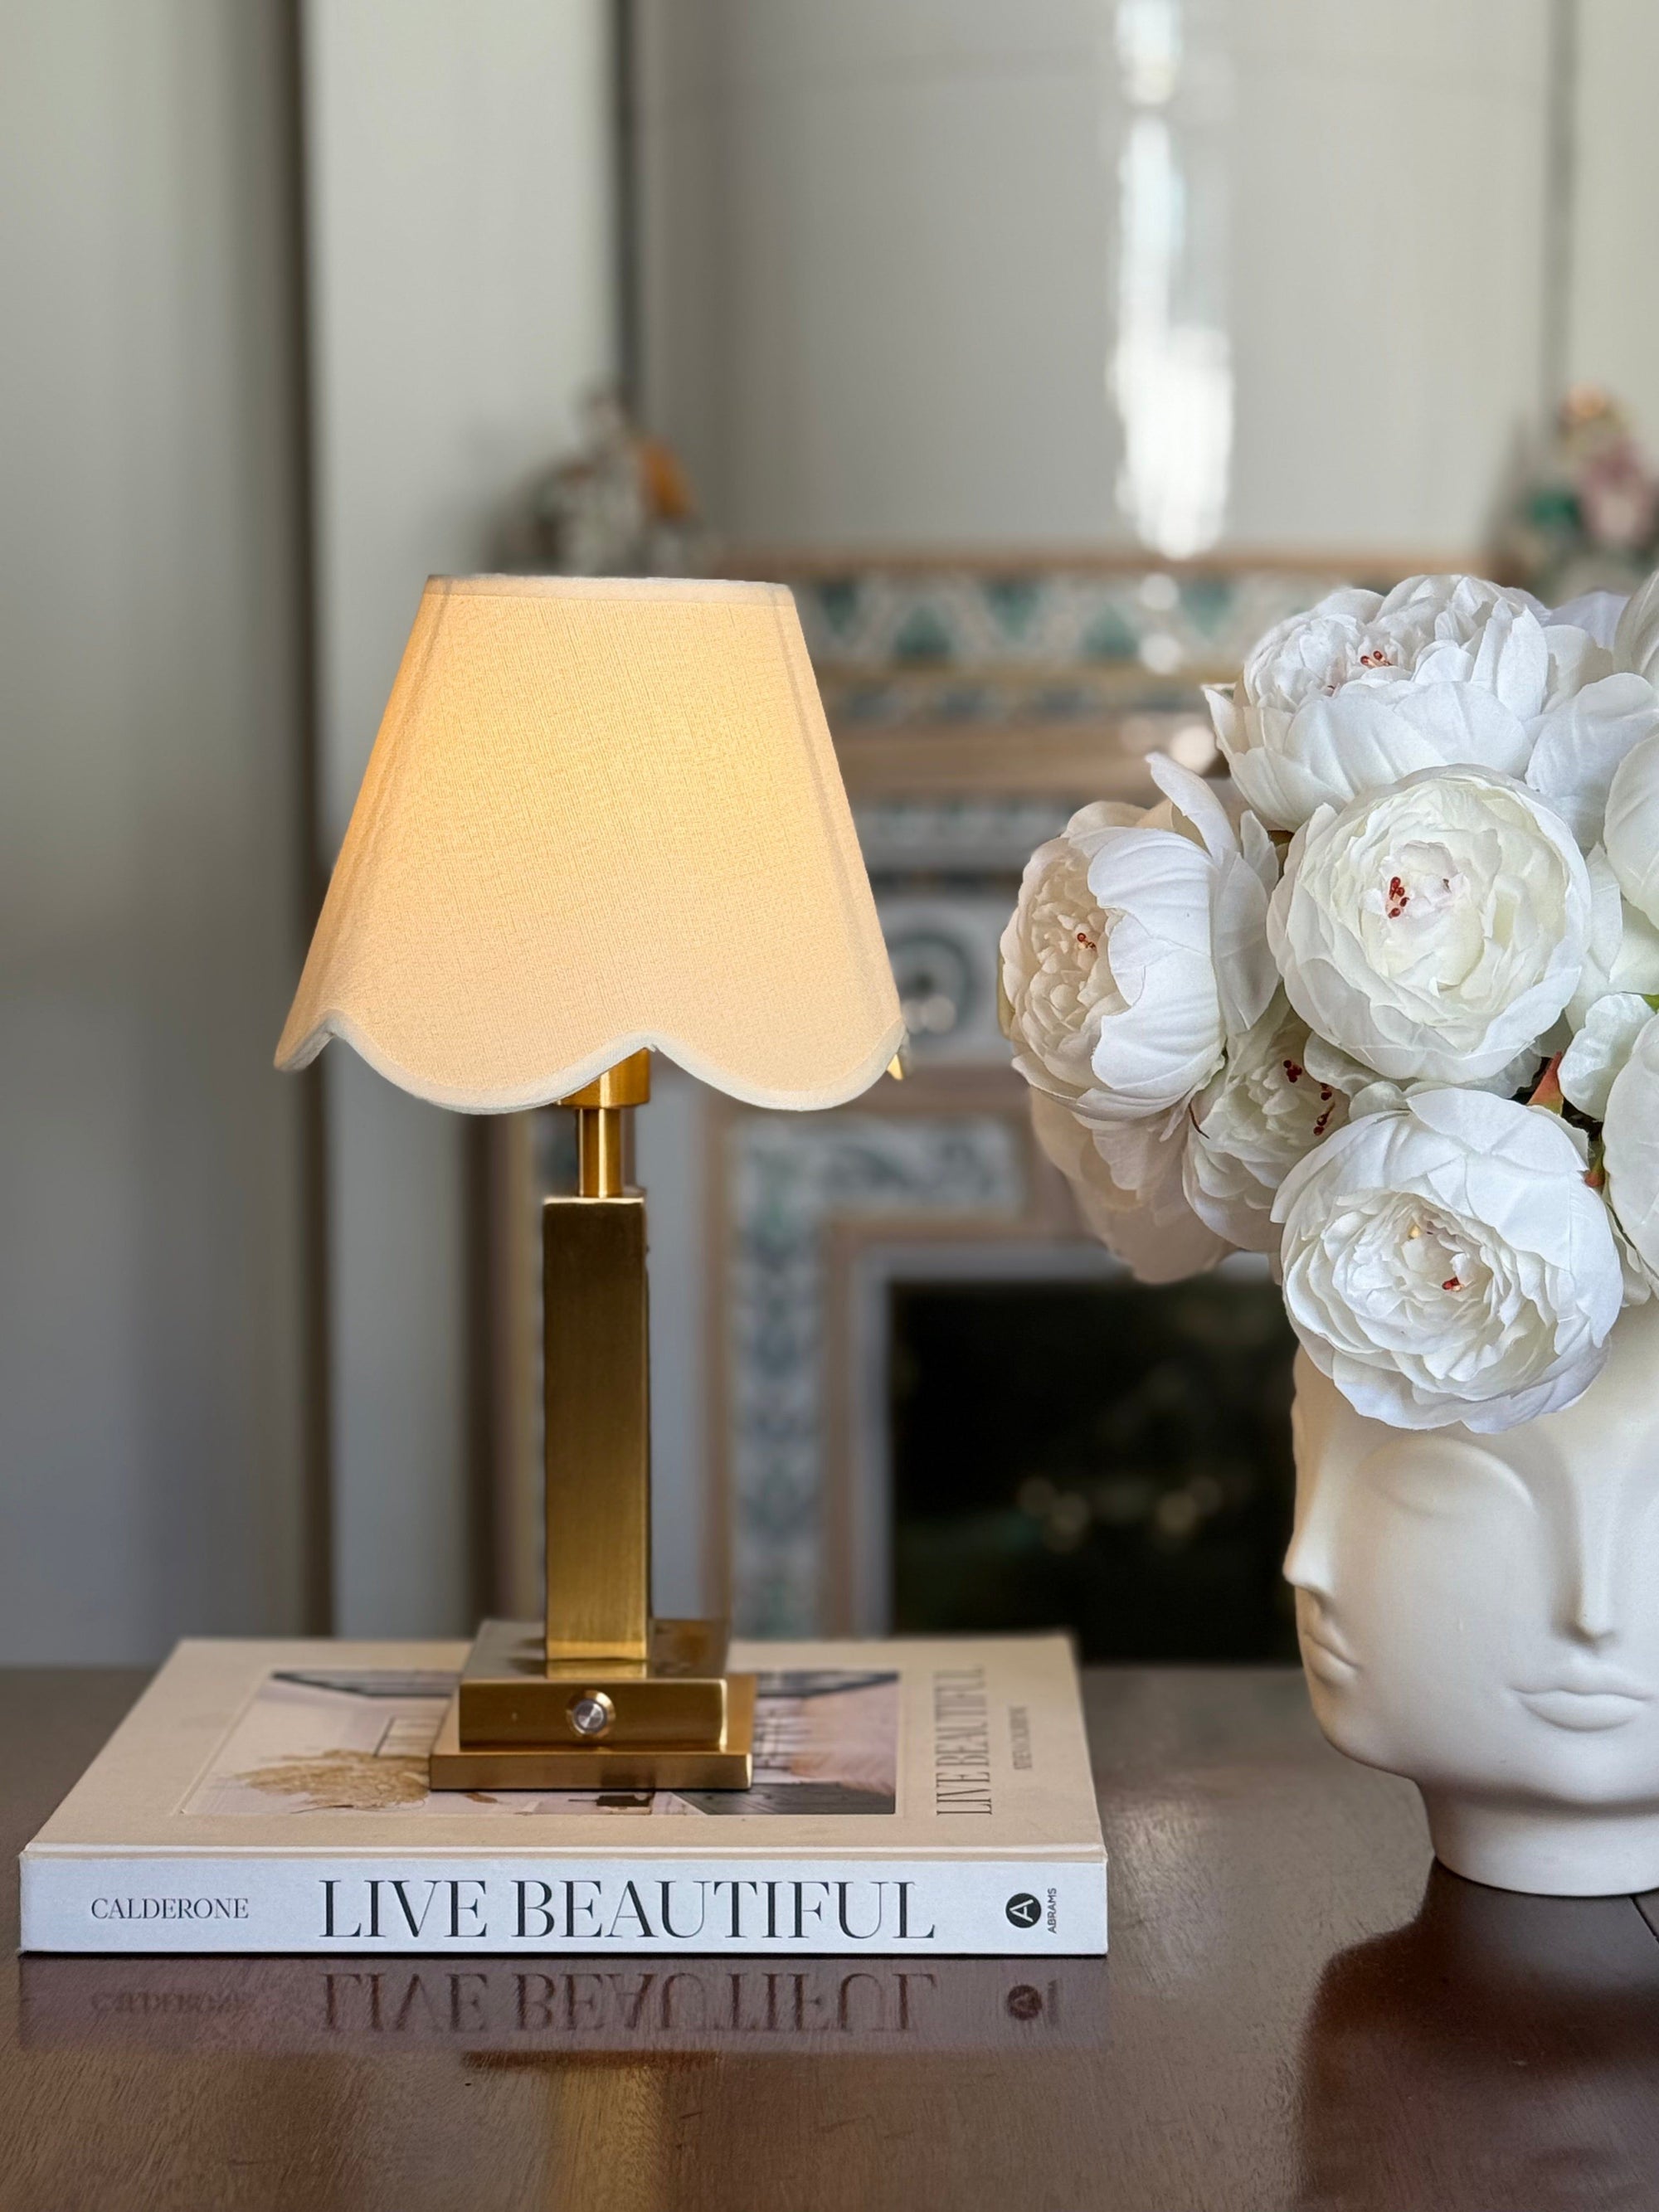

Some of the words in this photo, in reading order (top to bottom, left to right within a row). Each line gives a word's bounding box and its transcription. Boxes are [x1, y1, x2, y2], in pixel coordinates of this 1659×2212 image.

[936, 1772, 992, 1816] LIVE
[91, 1898, 249, 1919] CALDERONE
[319, 1879, 487, 1937] LIVE
[510, 1880, 935, 1938] BEAUTIFUL
[1047, 1888, 1058, 1934] ABRAMS
